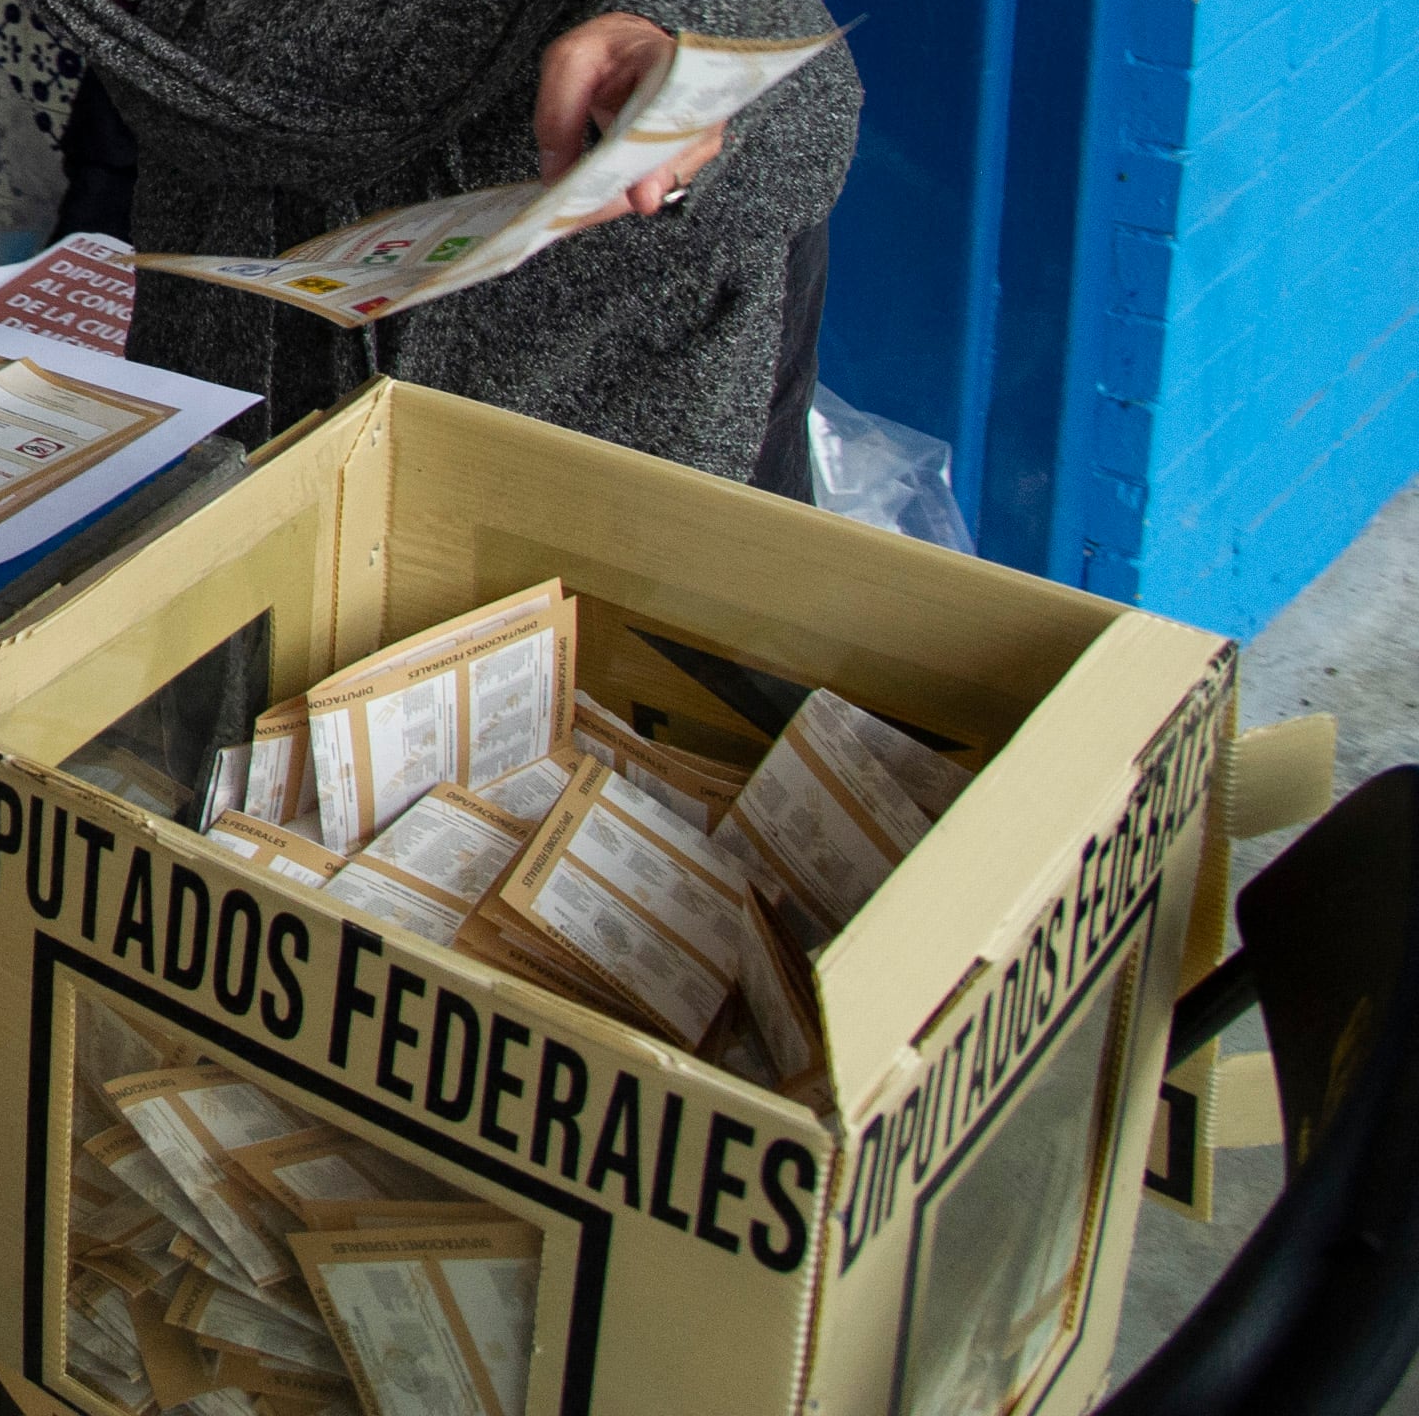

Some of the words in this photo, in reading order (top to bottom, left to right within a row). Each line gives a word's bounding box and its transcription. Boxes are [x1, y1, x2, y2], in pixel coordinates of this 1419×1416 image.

[5, 293, 47, 314] DE
[41, 307, 77, 326] LA
[30, 278, 65, 297] AL
[67, 289, 133, 321] CONG
[465, 619, 537, 656] DIPUTACIONES
[406, 649, 465, 679] FEDERALES
[227, 820, 288, 850] FEDERALES
[328, 919, 820, 1276] FEDERALES
[839, 898, 1065, 1276] DIPUTADOS
